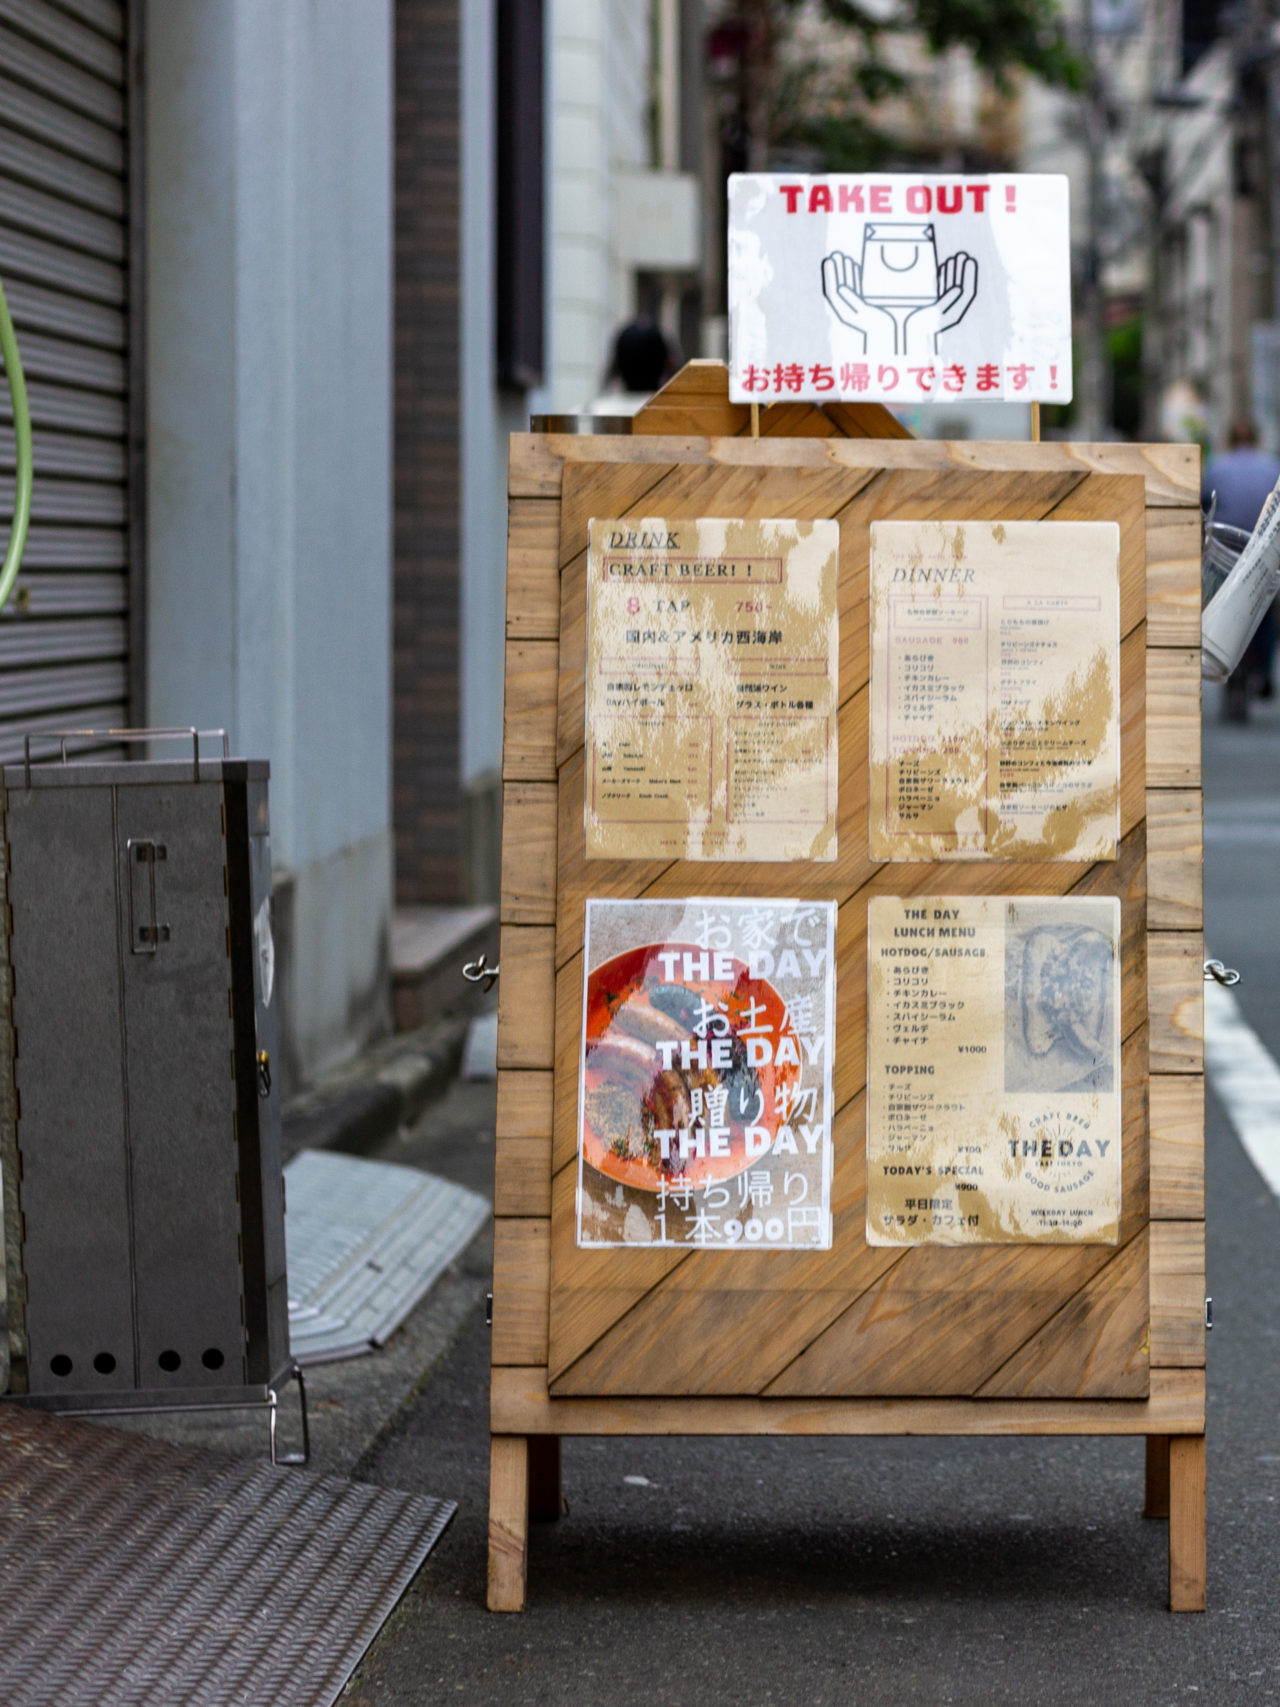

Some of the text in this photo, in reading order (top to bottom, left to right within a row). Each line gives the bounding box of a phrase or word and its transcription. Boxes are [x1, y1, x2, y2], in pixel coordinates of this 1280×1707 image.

[779, 185, 892, 214] TAKE
[608, 532, 681, 549] DRINK
[609, 564, 671, 577] CRAFT
[891, 567, 976, 584] DINNER
[626, 597, 641, 616] 8
[655, 600, 691, 613] TAP
[895, 636, 943, 645] SAUSAGE
[903, 664, 934, 672] コリコリ
[903, 674, 949, 682] チキンカレー
[903, 684, 966, 692] イカスミブラック
[898, 759, 920, 768] チーズ
[898, 768, 942, 776] チリビーンズ
[904, 909, 960, 921] THE DAY
[694, 907, 821, 950] お家で
[893, 927, 977, 938] LUNCH MENU
[880, 947, 987, 959] HOTDOG/SAUSAGE
[658, 949, 827, 982] THE DAY
[893, 966, 930, 975] あらびき
[893, 977, 929, 986] コリコリ
[893, 989, 947, 998] チキンカレー
[893, 1001, 965, 1010] イカスミブラック
[692, 995, 818, 1039] お土産
[893, 1036, 930, 1045] チャイナ
[655, 1036, 826, 1070] THE DAY
[957, 1045, 988, 1054] ¥1000
[884, 1065, 935, 1076] TOPPING
[888, 1083, 912, 1091] チーズ
[888, 1093, 935, 1101] チリビーンズ
[688, 1082, 819, 1128] 贈り物
[1029, 1111, 1091, 1131] CRAFT BEER
[653, 1124, 824, 1159] THE DAY
[1008, 1139, 1111, 1158] THE DAY
[883, 1166, 984, 1176] TODAY'S SPECIAL
[1025, 1170, 1095, 1194] GOOD SAUSAGE
[656, 1170, 808, 1211] 持ち帰り
[904, 1199, 953, 1211] 平日限定
[883, 1214, 980, 1227] サラダ・カフェ付
